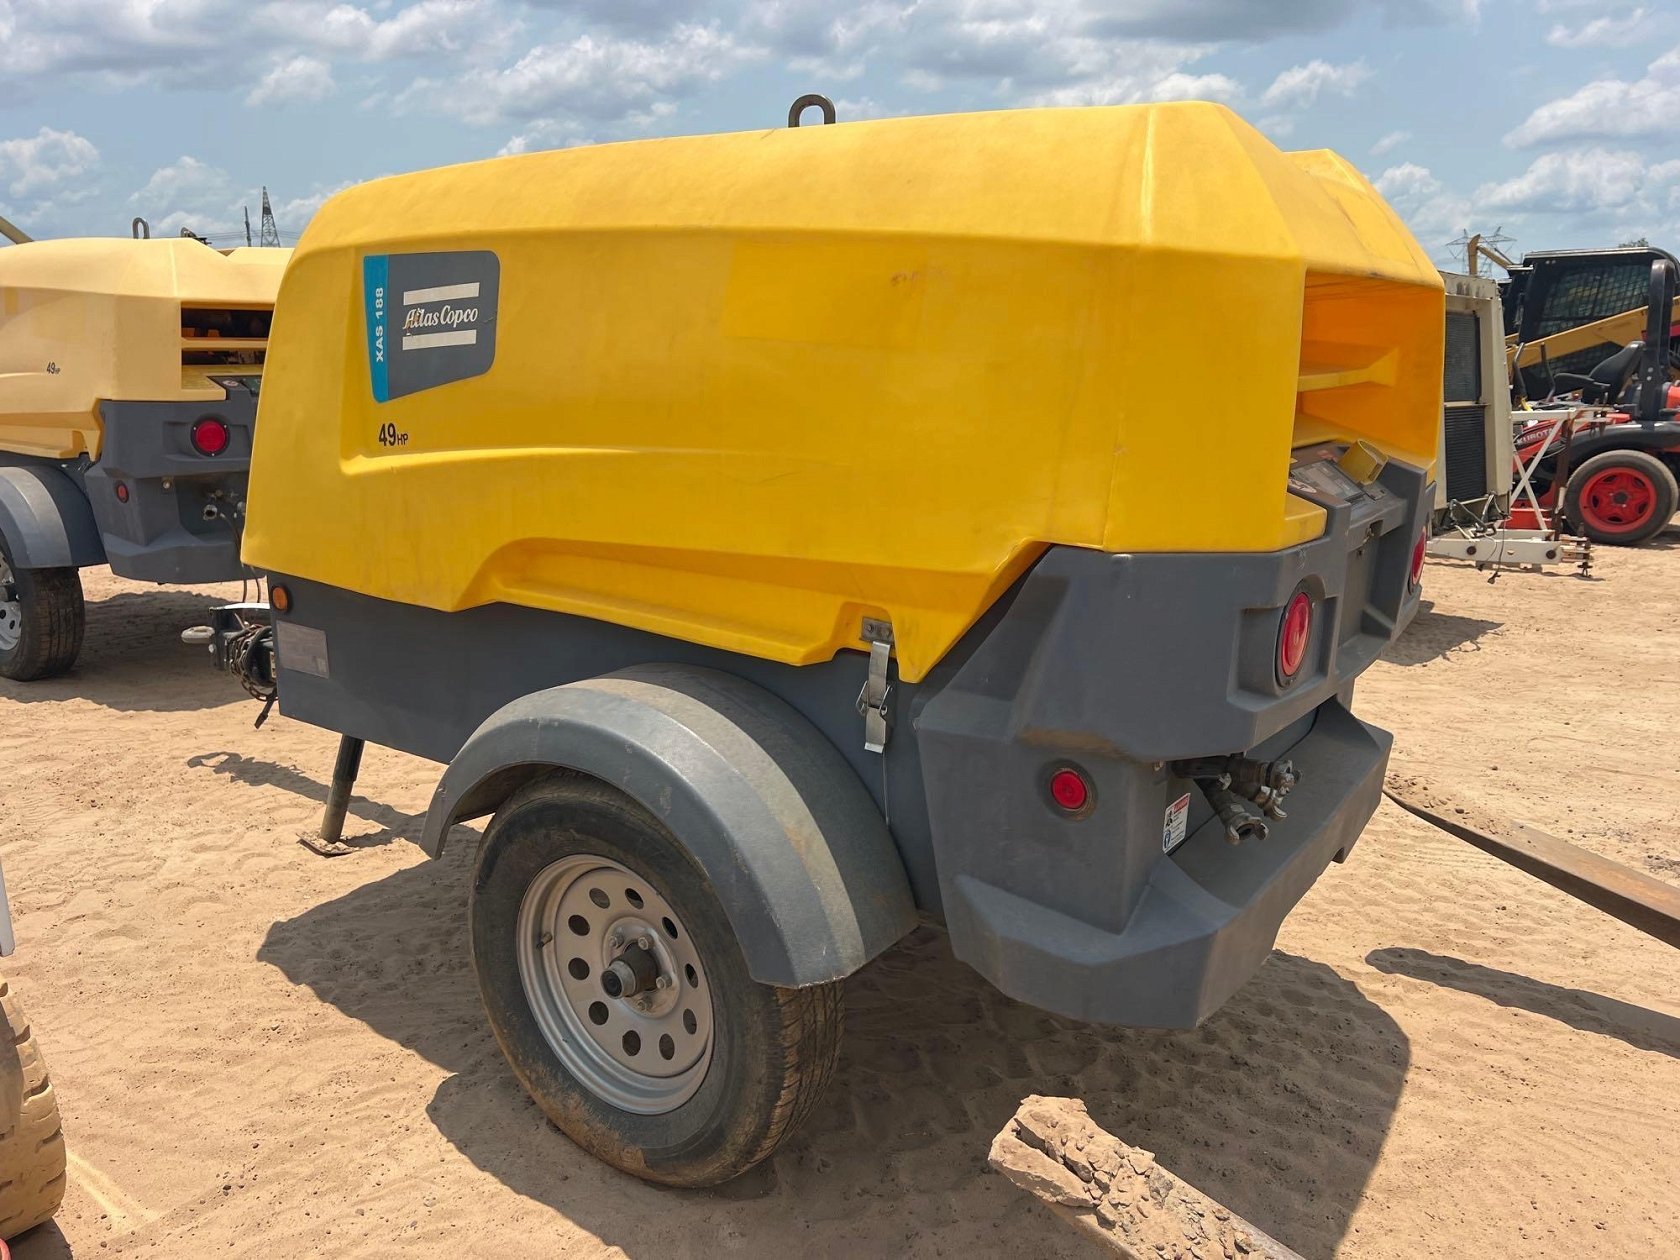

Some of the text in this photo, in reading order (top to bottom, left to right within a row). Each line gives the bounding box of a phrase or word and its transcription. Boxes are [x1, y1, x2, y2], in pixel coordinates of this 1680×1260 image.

[375, 287, 384, 363] XAS 188
[402, 304, 479, 330] Atlas Copco
